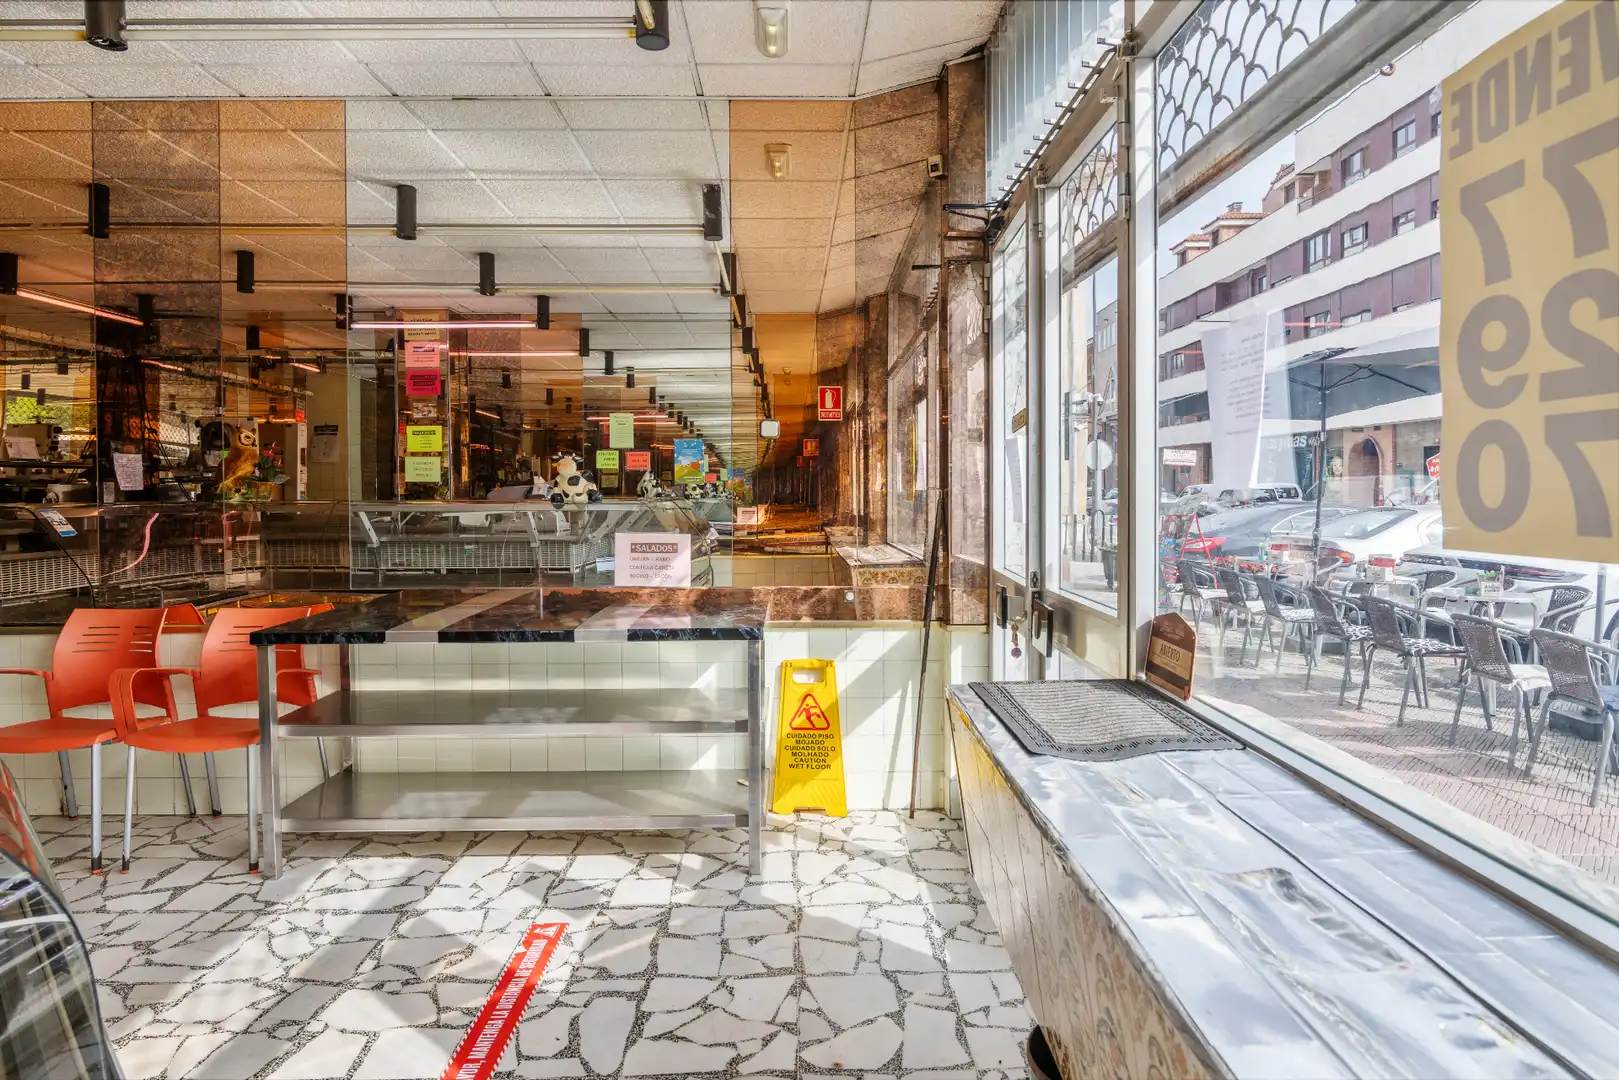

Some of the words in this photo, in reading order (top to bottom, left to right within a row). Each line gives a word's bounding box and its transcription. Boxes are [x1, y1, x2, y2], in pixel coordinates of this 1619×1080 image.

[1160, 643, 1181, 662] ABIERTO
[496, 977, 529, 1010] DISTANCIA
[491, 1010, 510, 1019] LA
[467, 1018, 505, 1059] MANTENGA
